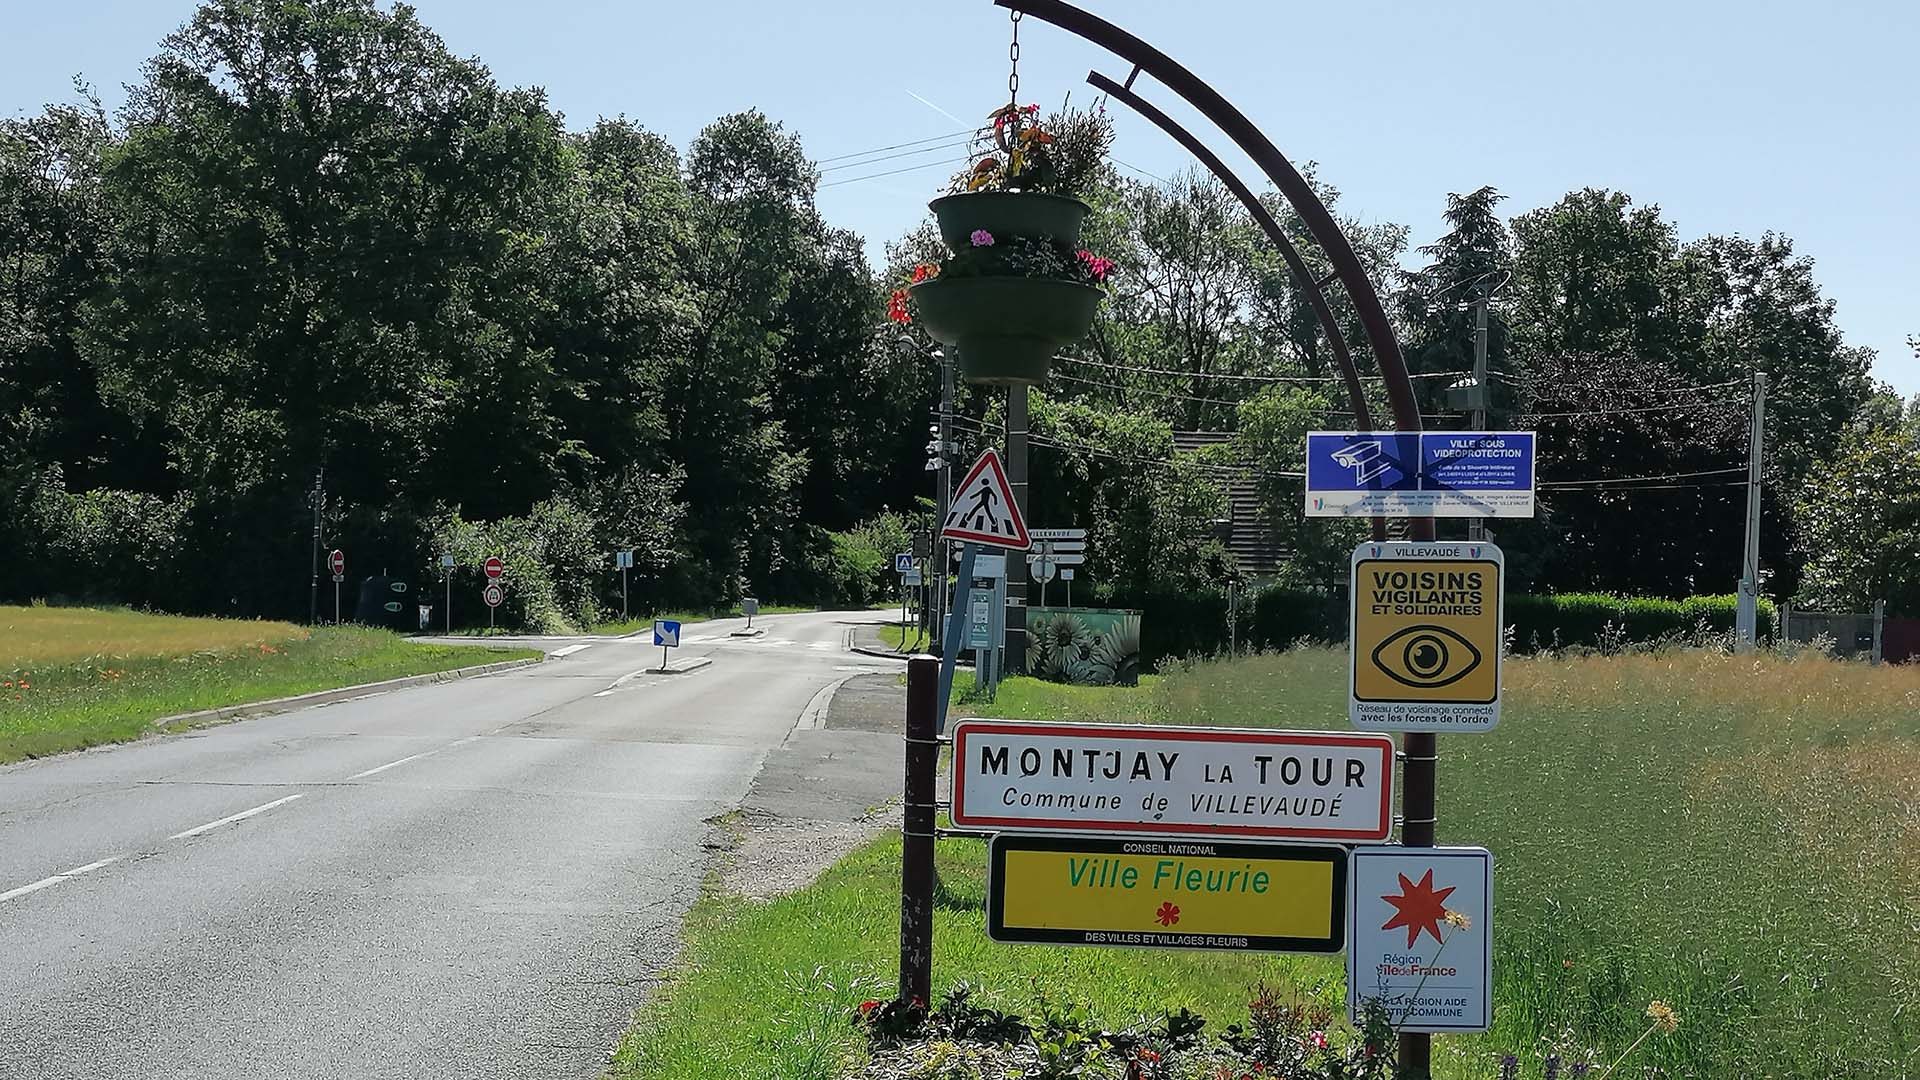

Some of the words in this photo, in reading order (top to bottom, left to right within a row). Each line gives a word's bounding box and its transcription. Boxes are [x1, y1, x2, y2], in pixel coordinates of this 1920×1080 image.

[1450, 440, 1475, 448] VILLE
[1480, 440, 1505, 448] SOUS
[1433, 449, 1522, 458] VIDEOPROTECTION
[1394, 547, 1461, 557] VILLEVAUDÉ
[1373, 571, 1482, 590] VOISINS
[1372, 590, 1482, 605] VIGILANTS
[1372, 605, 1390, 615] ET
[1394, 605, 1482, 616] SOLIDAIRES
[1356, 704, 1392, 713] Réseau
[1393, 704, 1405, 713] de
[1407, 705, 1450, 716] voisinage
[1452, 705, 1494, 716] connecté
[1360, 714, 1385, 722] avec
[1387, 713, 1402, 723] les
[1405, 713, 1437, 723] forces
[1440, 713, 1453, 724] de
[1455, 714, 1489, 724] l'ordre
[980, 746, 1179, 781] MONTJAY
[1204, 764, 1233, 784] LA
[1254, 755, 1366, 788] TOUR
[1002, 787, 1122, 810] Commune
[1142, 792, 1169, 812] de
[1190, 793, 1343, 817] VILLEVAUDÉ
[1123, 843, 1166, 854] CONSEIL
[1168, 844, 1217, 855] NATIONAL
[1068, 857, 1139, 889] Ville
[1153, 860, 1270, 894] Fleurie
[1085, 932, 1106, 942] DES
[1107, 933, 1141, 943] VILLES
[1143, 935, 1155, 944] ET
[1157, 935, 1204, 946] VILLAGES
[1206, 936, 1248, 947] FLEURIS
[1383, 954, 1422, 966] Région
[1445, 998, 1467, 1006] AIDE
[1412, 1008, 1463, 1017] COMMUNE
